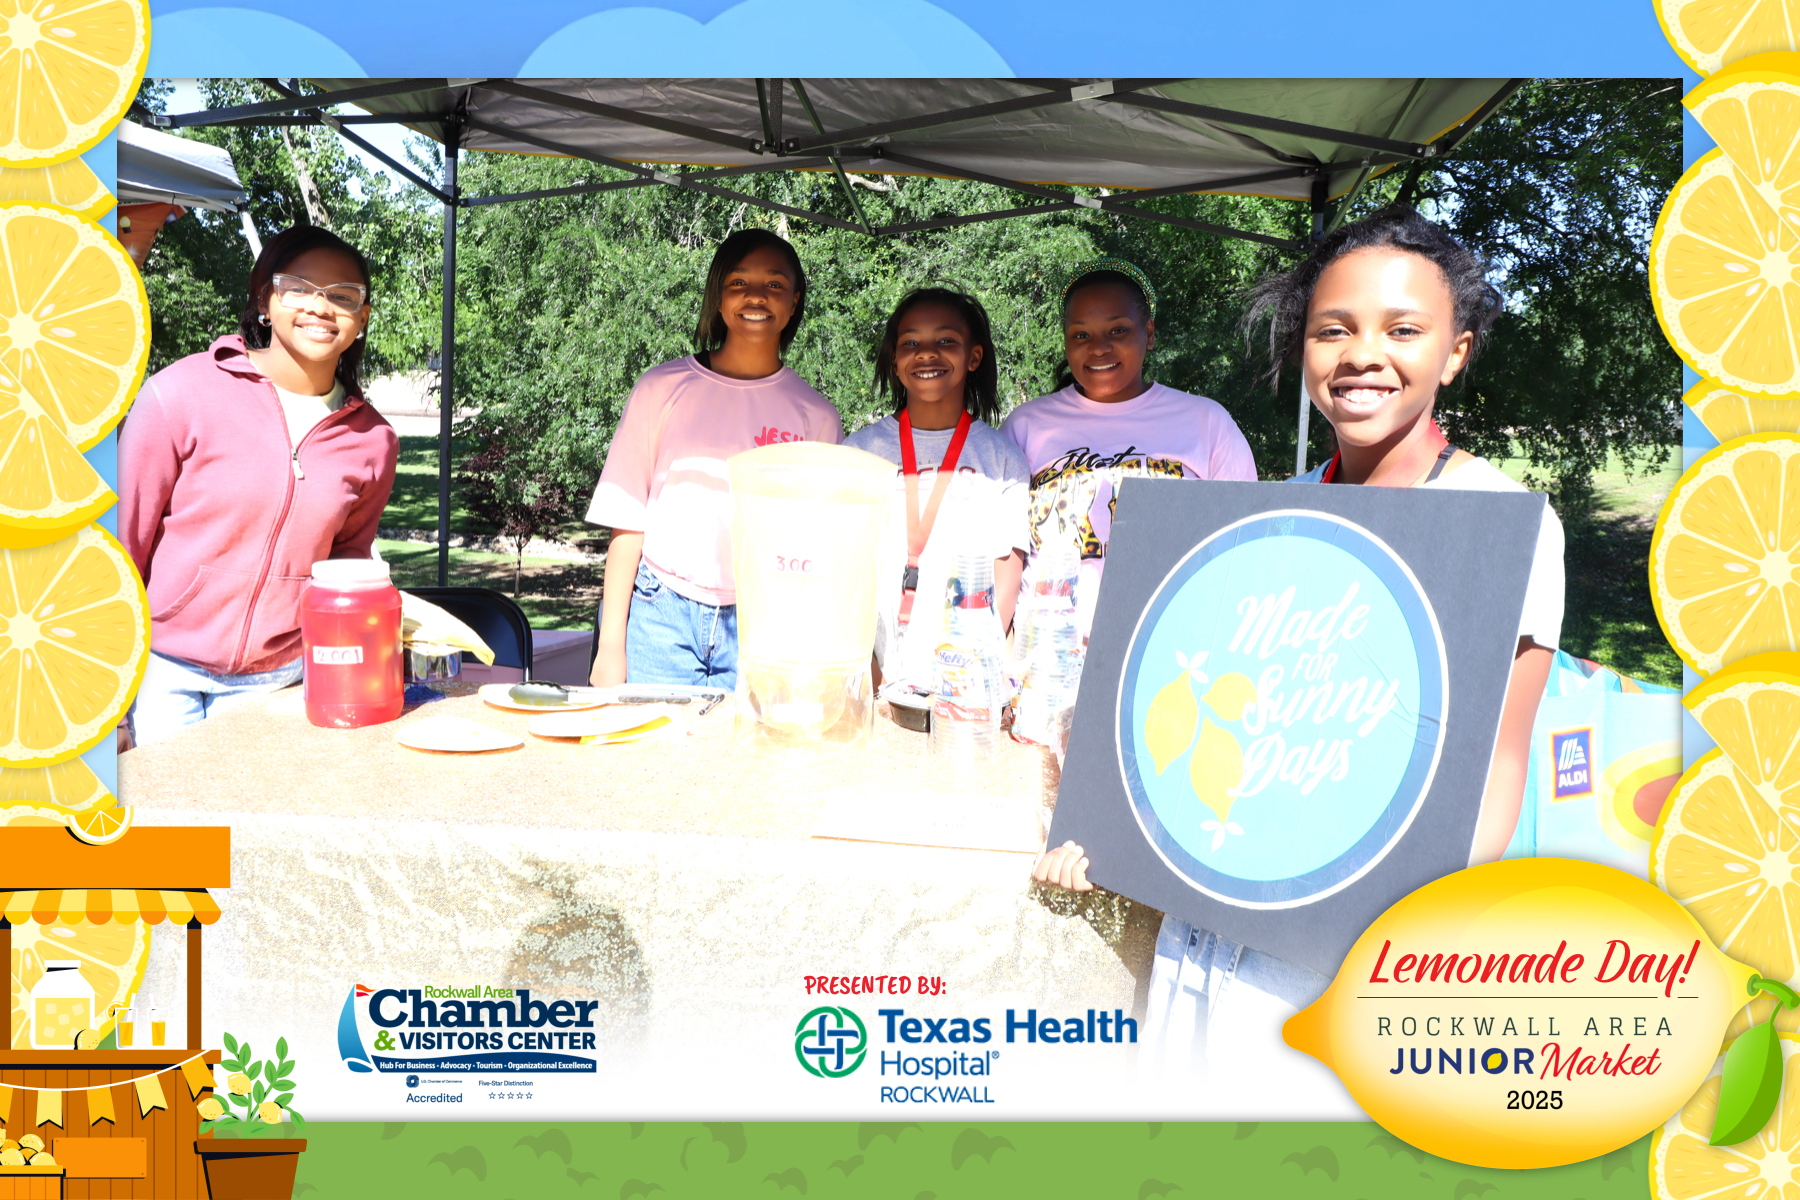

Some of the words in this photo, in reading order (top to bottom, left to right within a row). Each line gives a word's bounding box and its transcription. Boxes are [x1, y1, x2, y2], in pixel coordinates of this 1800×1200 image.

[1228, 581, 1370, 660] Made
[1291, 652, 1338, 681] FOR
[1242, 664, 1400, 737] Sunny
[1226, 730, 1353, 797] Days
[1558, 769, 1588, 788] ALDI
